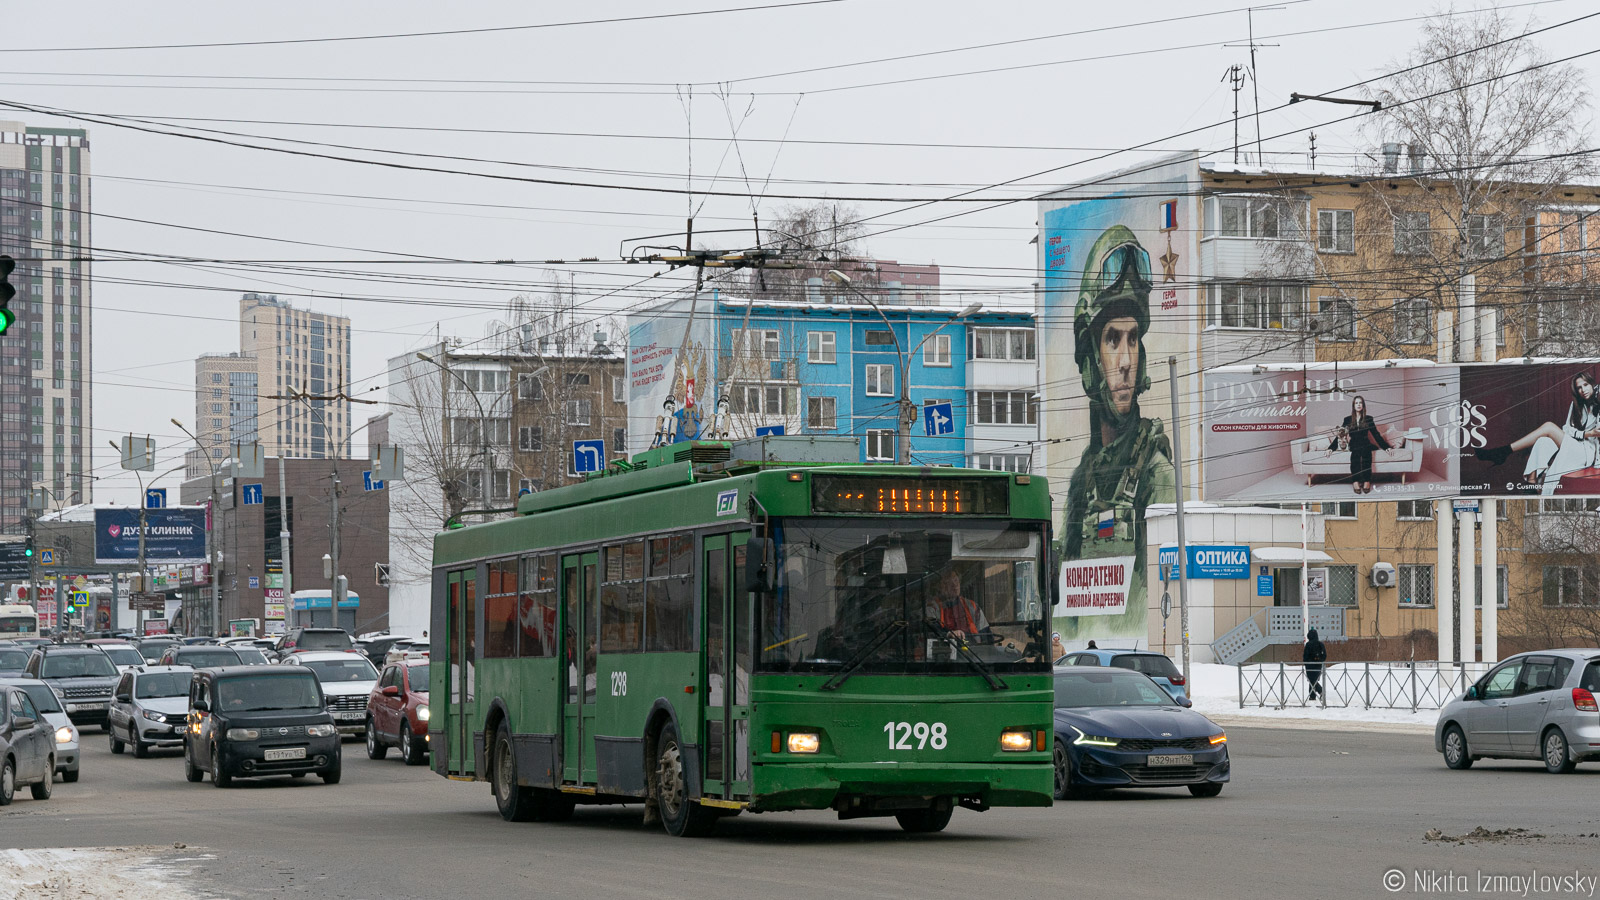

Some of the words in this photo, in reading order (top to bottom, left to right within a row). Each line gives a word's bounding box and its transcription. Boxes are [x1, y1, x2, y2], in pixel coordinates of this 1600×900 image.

[1212, 378, 1353, 404] ГРУМИНГ
[1430, 426, 1487, 448] MOS
[151, 526, 193, 535] КЛИНИК
[1196, 551, 1248, 565] ОПТИКА
[1066, 564, 1124, 590] КОНДРАТЕНКО
[1066, 591, 1091, 608] НИКОЛАЙ
[1092, 592, 1124, 609] АНДРЕЕВИЧ
[611, 671, 626, 696] 1298
[884, 722, 947, 750] 1298
